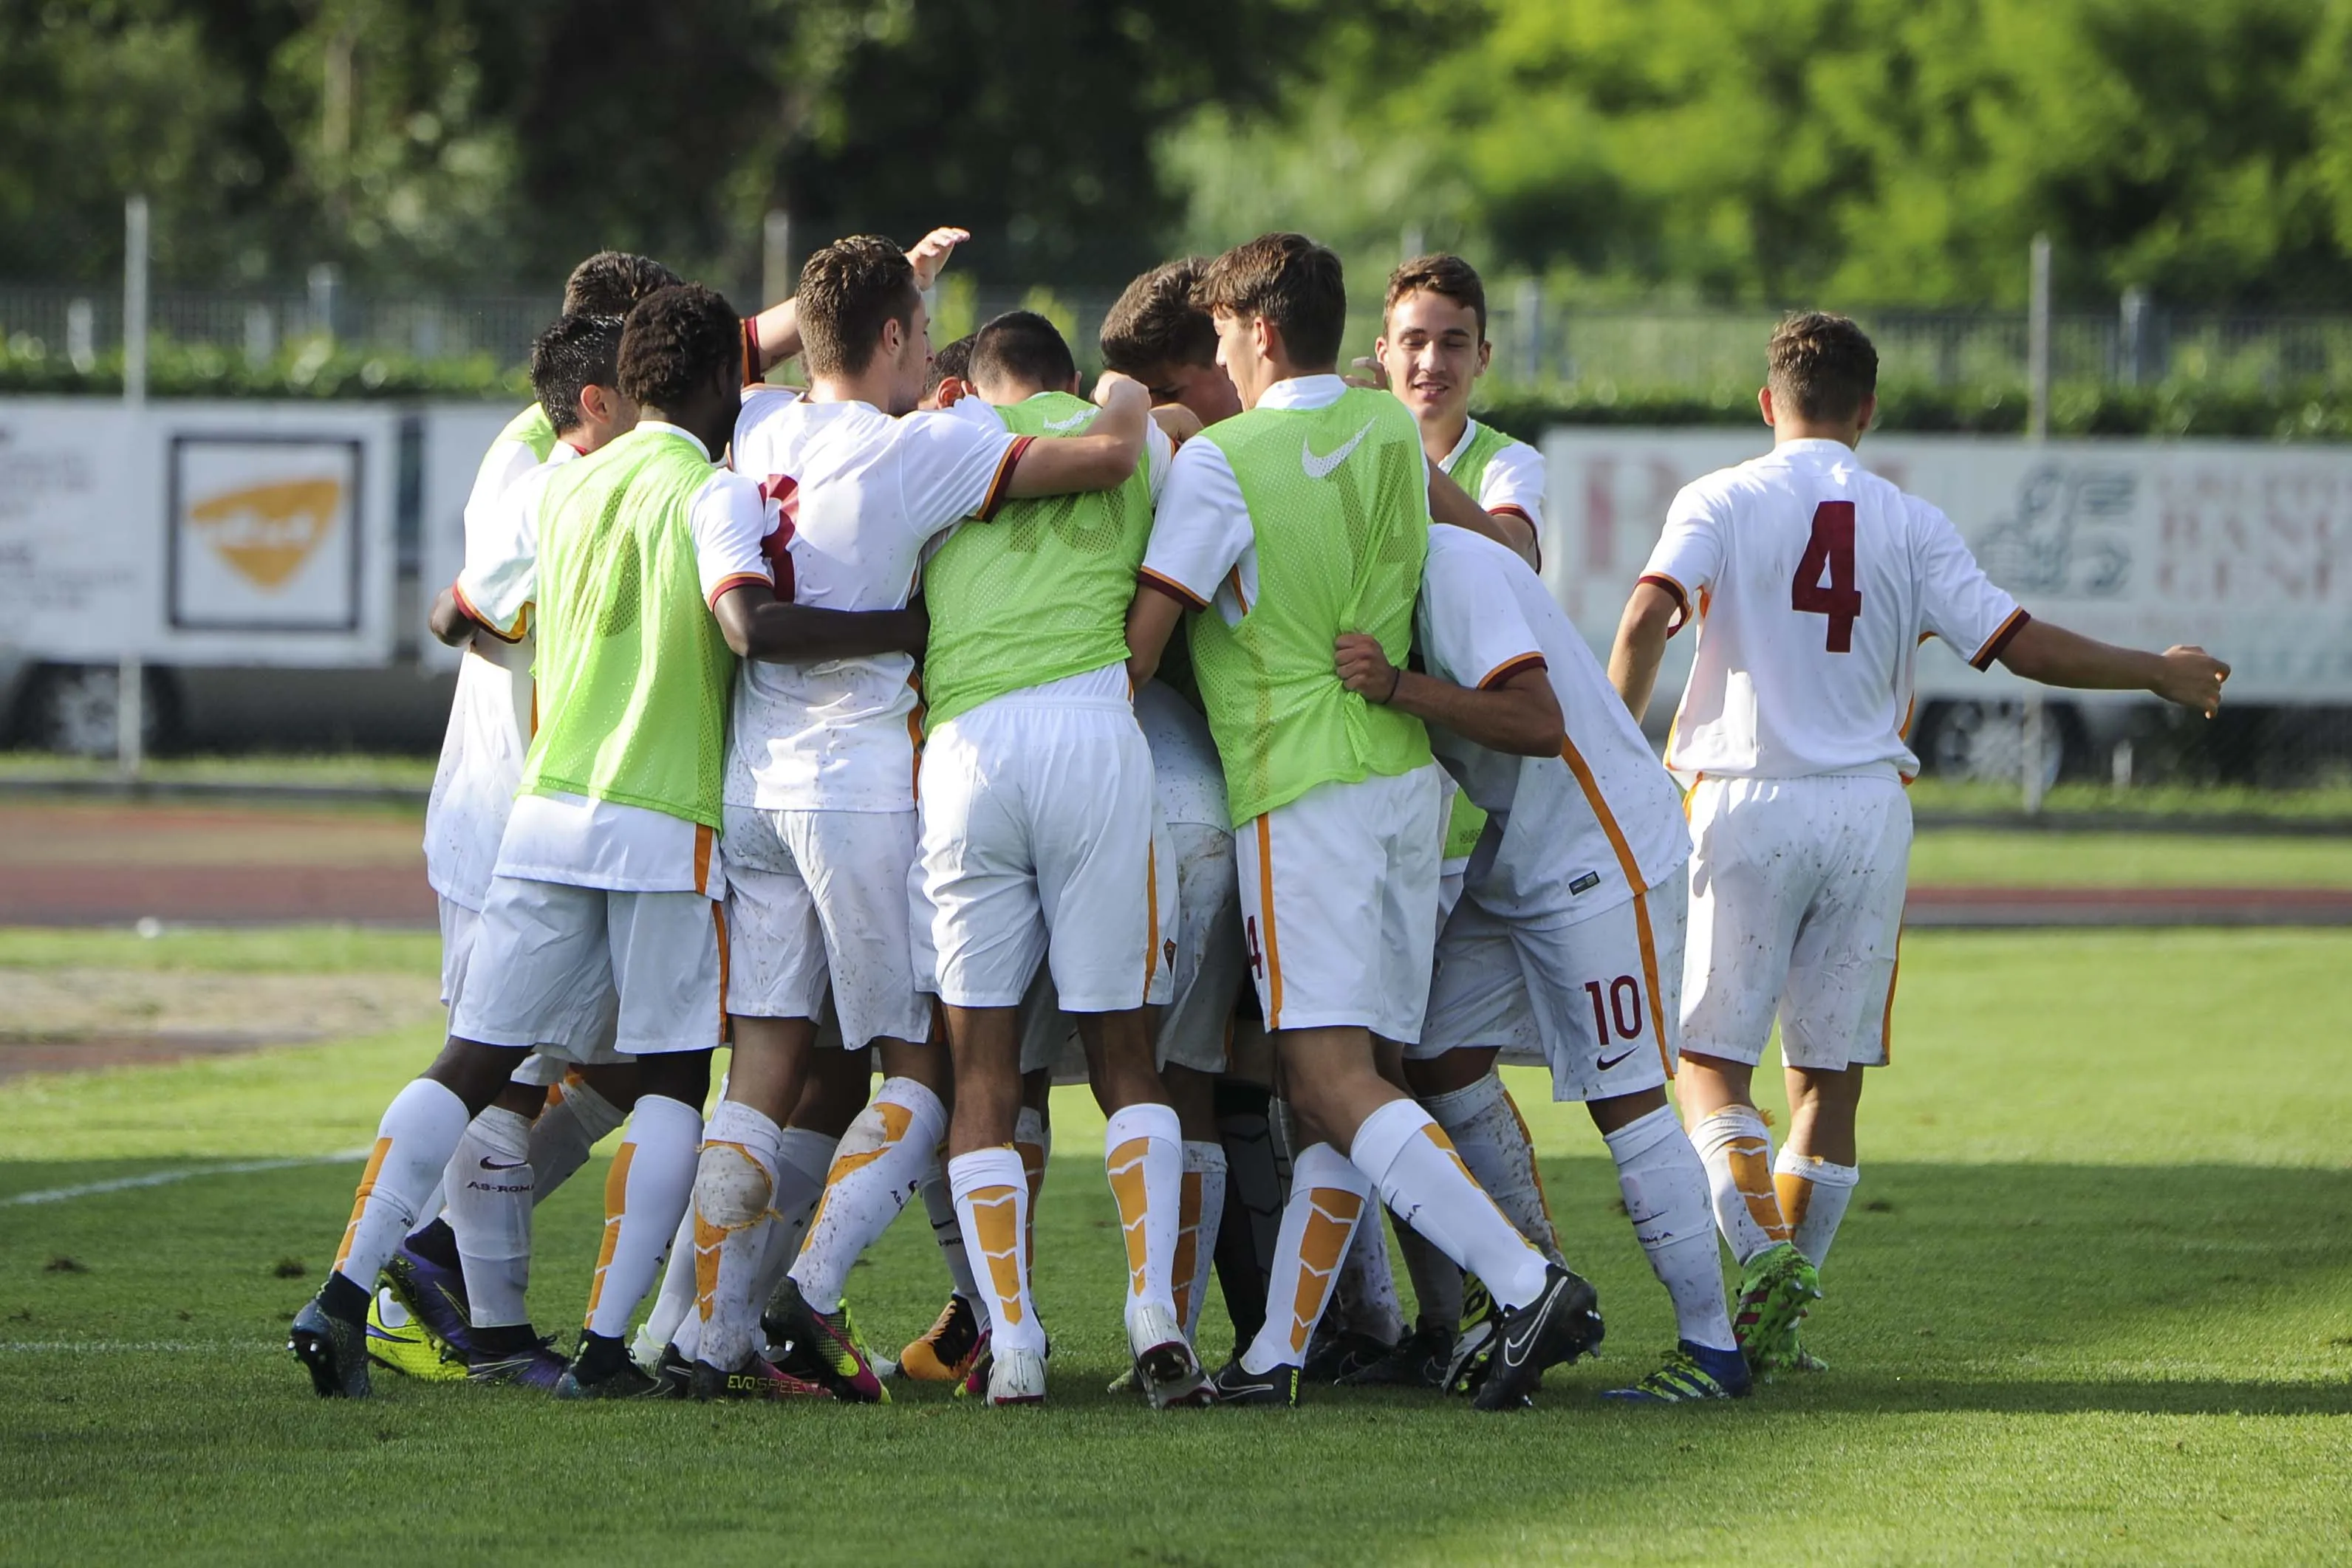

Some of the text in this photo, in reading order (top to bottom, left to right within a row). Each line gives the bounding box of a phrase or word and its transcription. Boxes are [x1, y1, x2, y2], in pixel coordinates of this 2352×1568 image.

[1791, 500, 1862, 653] 4
[1584, 975, 1642, 1046] 10
[466, 1181, 535, 1193] AS-ROM
